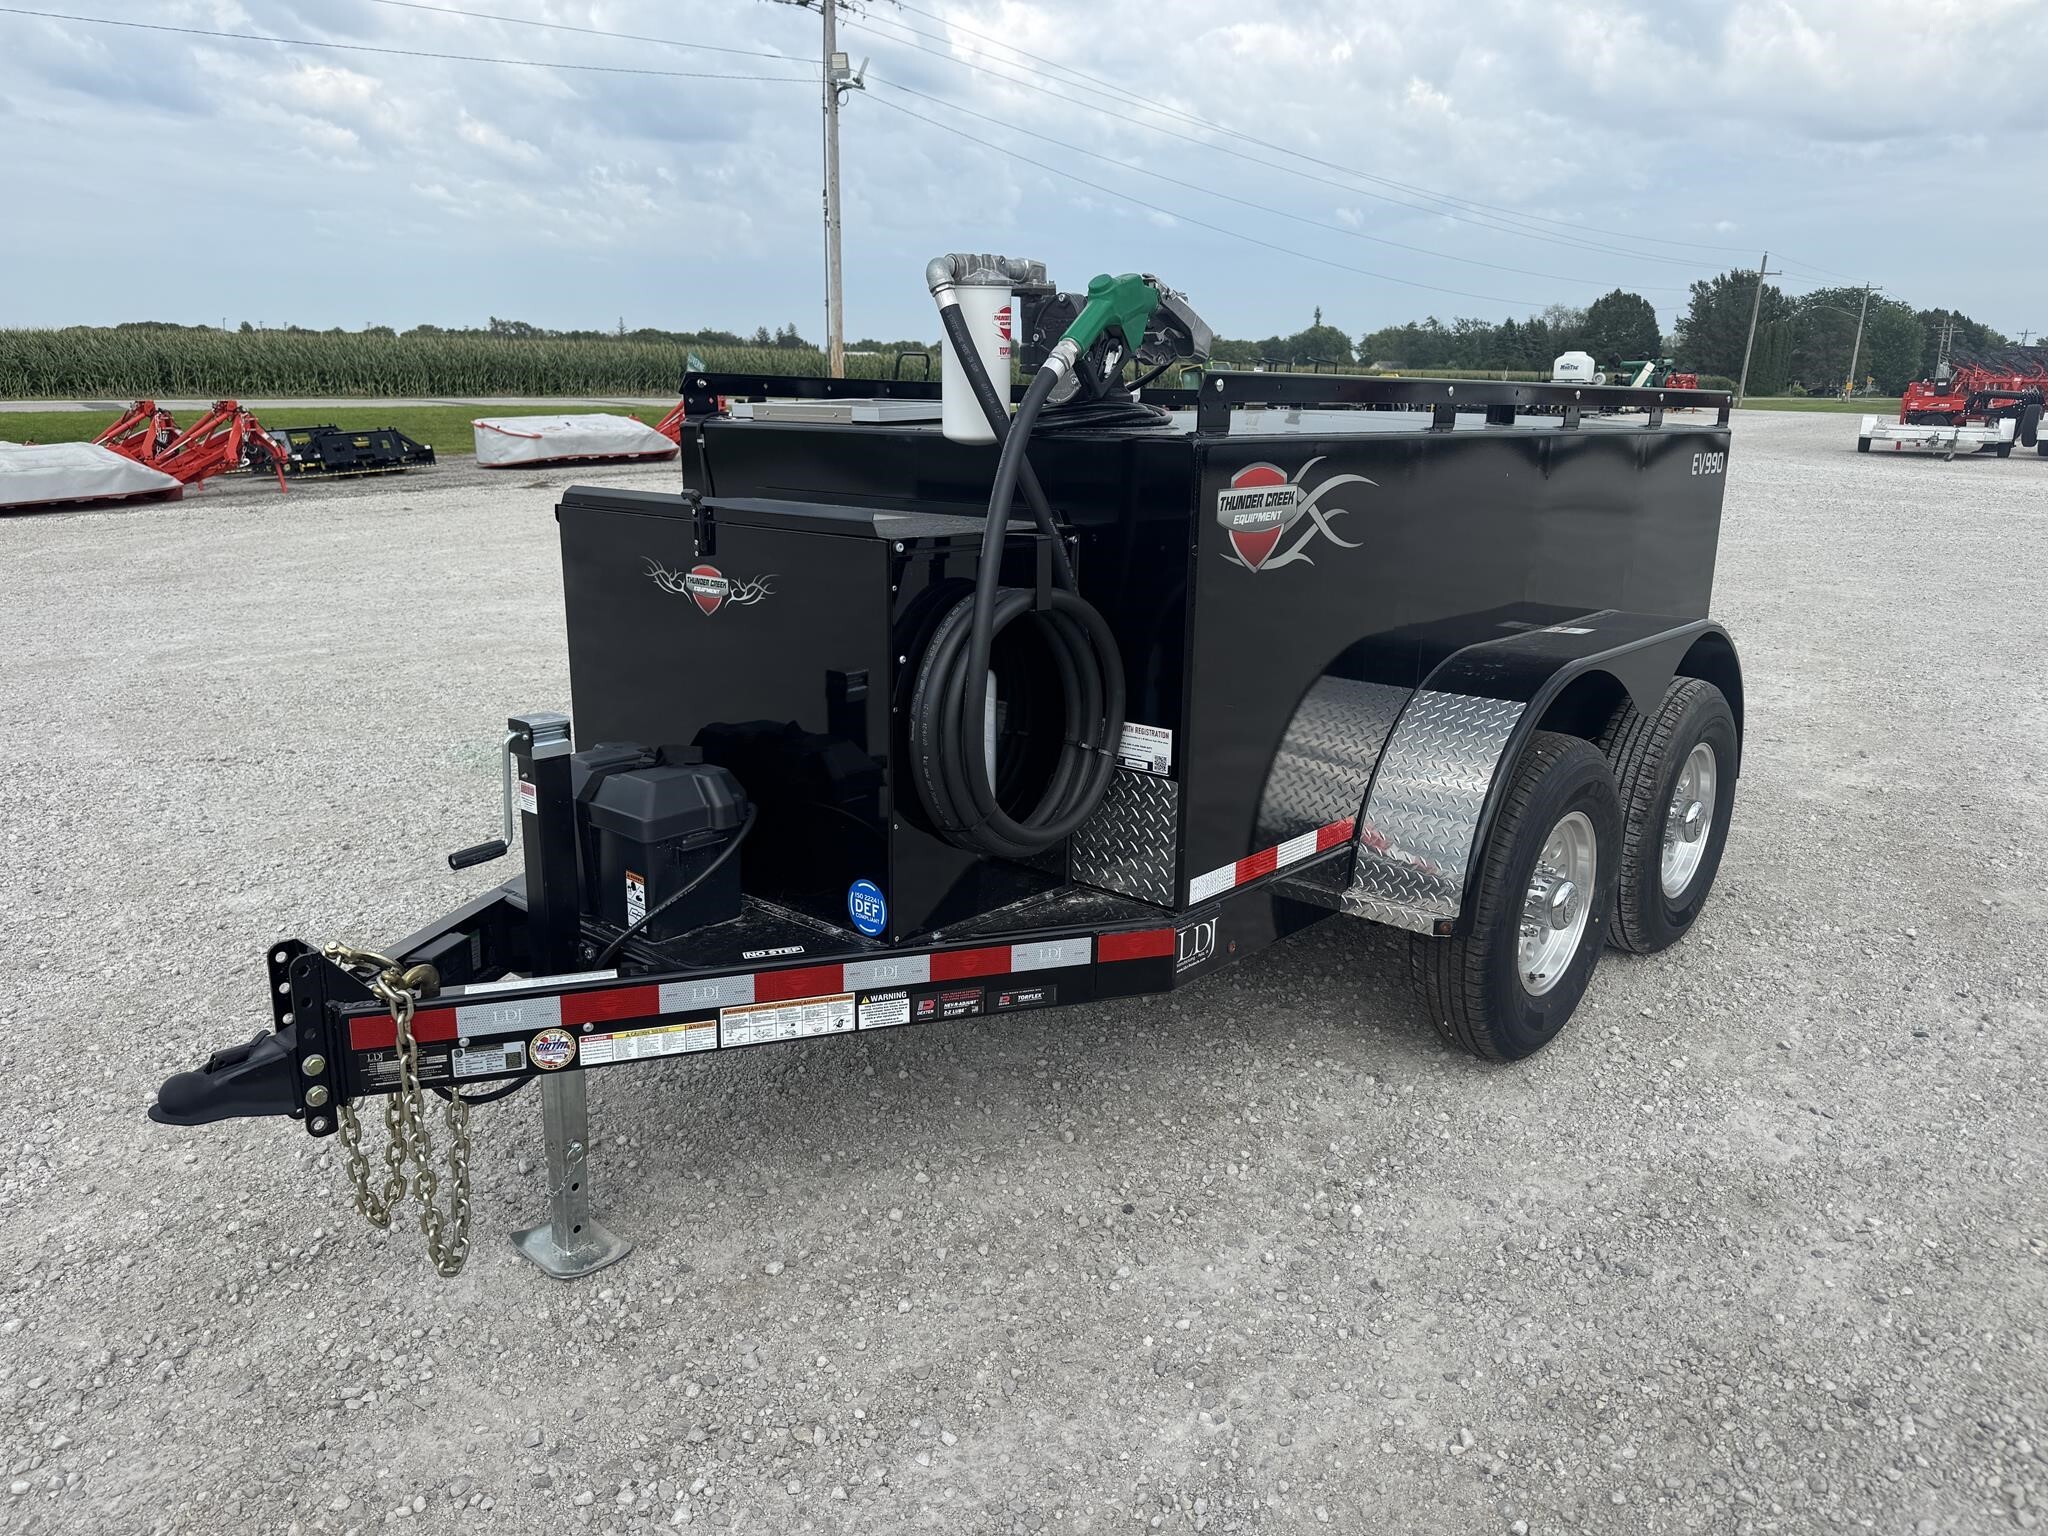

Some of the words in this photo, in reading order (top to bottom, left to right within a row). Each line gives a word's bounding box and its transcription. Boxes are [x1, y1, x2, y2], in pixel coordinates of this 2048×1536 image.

[1692, 452, 1724, 475] EV990
[1220, 493, 1264, 511] THUNDER
[1265, 490, 1296, 506] CREEK
[1233, 510, 1282, 525] EQUIPMENT
[687, 576, 710, 586] THUNDER
[710, 580, 727, 588] CREEK
[693, 586, 720, 594] EQUIPMENT
[1135, 727, 1170, 739] REGISTRATION
[864, 894, 880, 904] 22241
[855, 898, 880, 917] DEF
[855, 913, 880, 925] COMPLIANT
[1177, 916, 1219, 963] LDJ
[746, 950, 766, 959] NO
[768, 946, 802, 956] STEP
[1040, 947, 1062, 961] LDJ
[874, 965, 899, 979] LDJ
[693, 986, 719, 999] LDJ
[870, 991, 907, 1003] WARNING
[1018, 992, 1043, 1001] TORFLEX
[493, 1008, 523, 1024] LDJ
